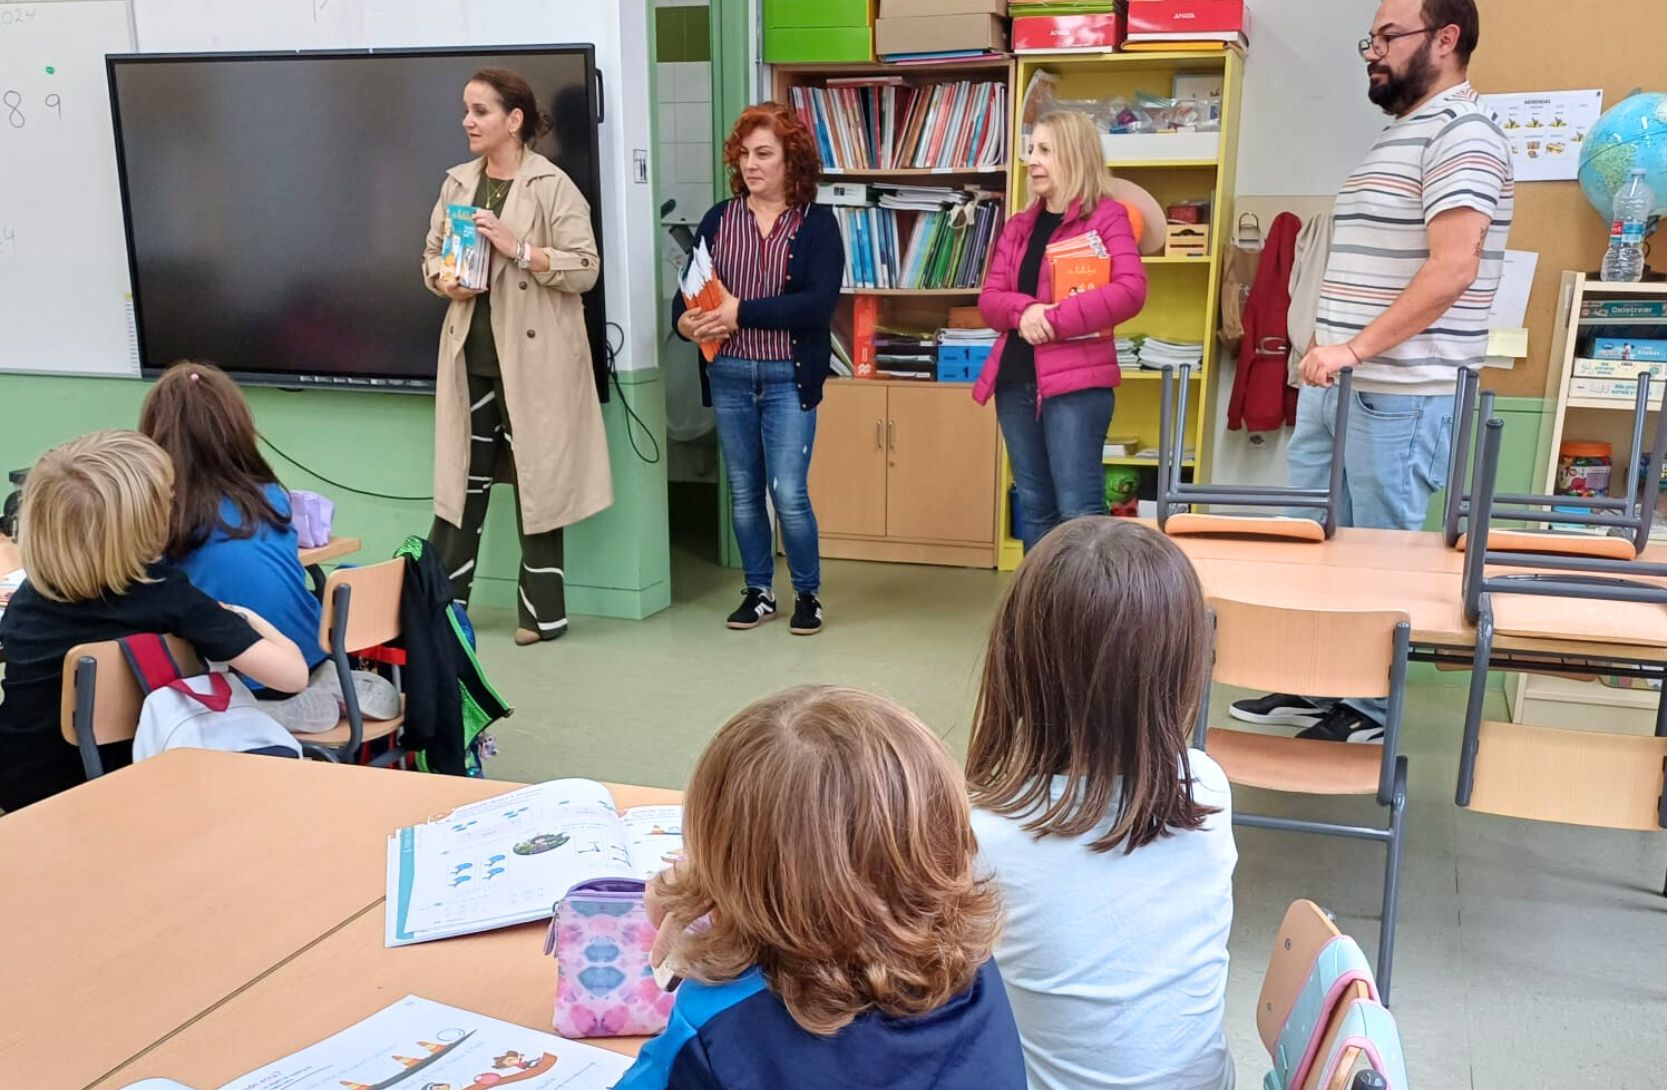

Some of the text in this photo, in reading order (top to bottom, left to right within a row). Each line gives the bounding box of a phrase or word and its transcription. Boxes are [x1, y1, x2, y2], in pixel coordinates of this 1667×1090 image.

[0, 8, 37, 26] 024
[3, 90, 62, 129] 8 9
[963, 349, 970, 360] 1
